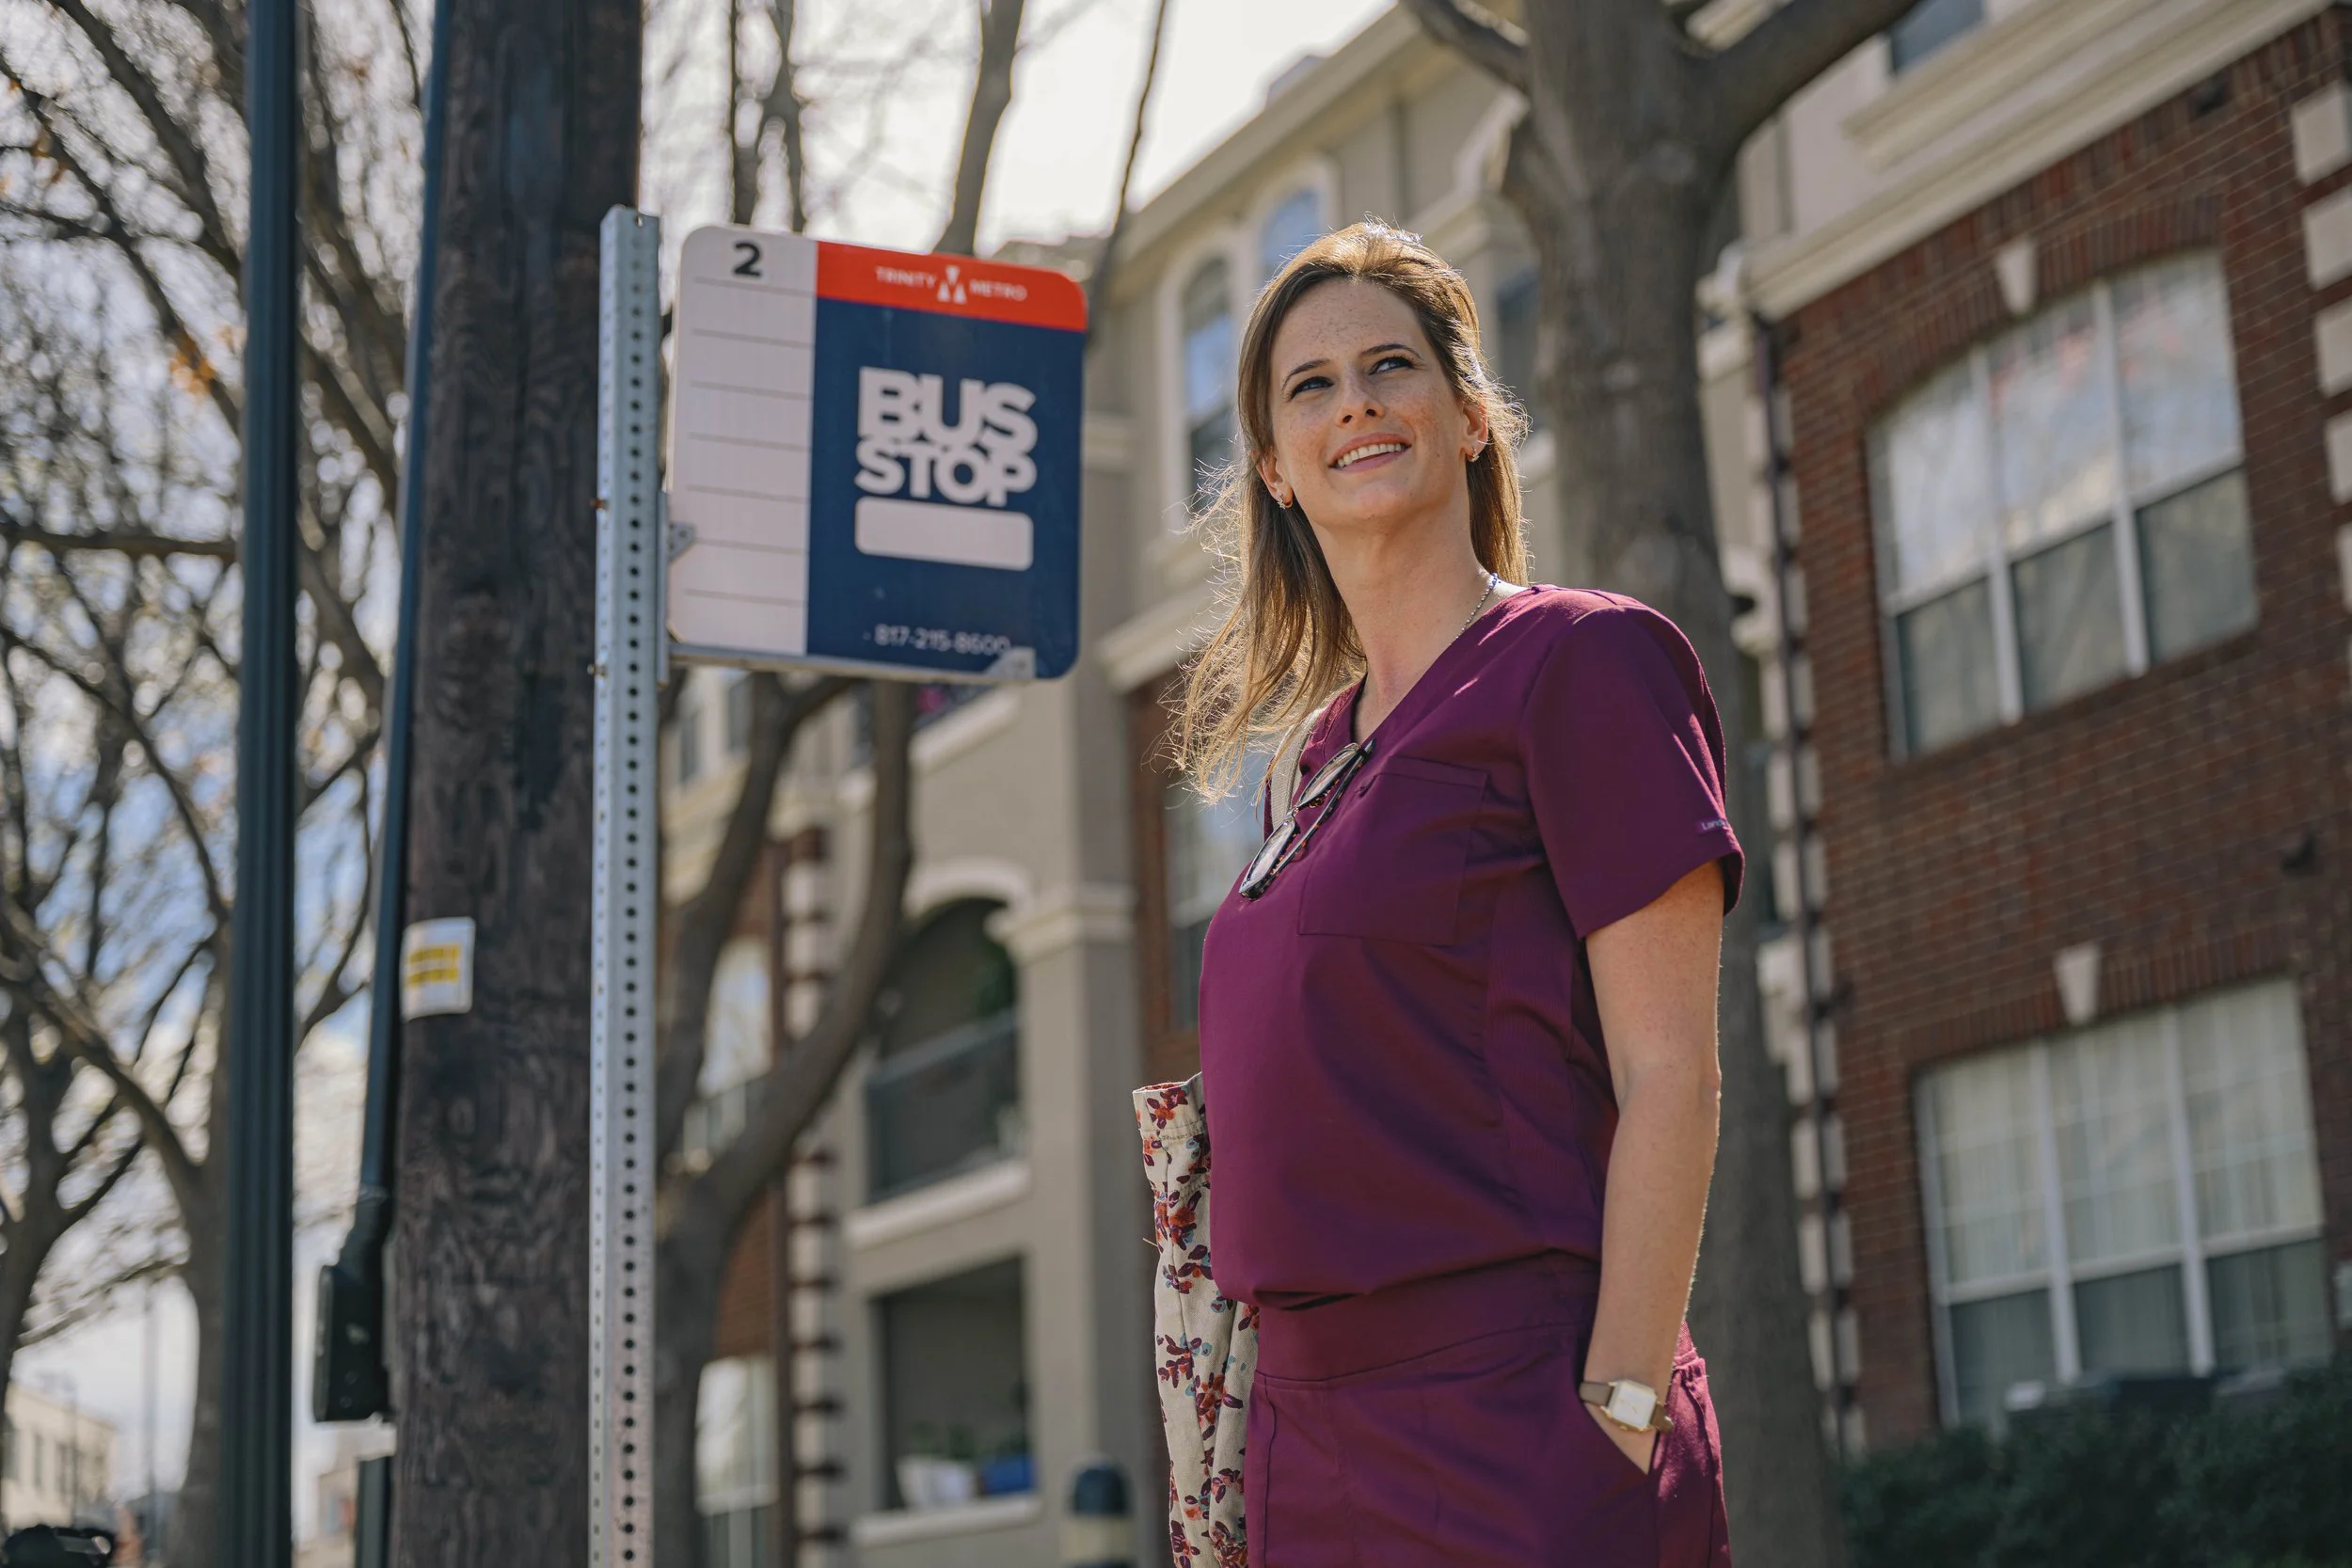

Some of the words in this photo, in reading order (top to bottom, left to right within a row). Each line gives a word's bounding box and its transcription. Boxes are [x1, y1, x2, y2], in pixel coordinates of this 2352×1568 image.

[733, 241, 762, 277] 2
[876, 266, 937, 289] TRINITY
[970, 279, 1027, 302] METRO
[858, 366, 1038, 455] BUS
[854, 438, 1038, 507] STOP
